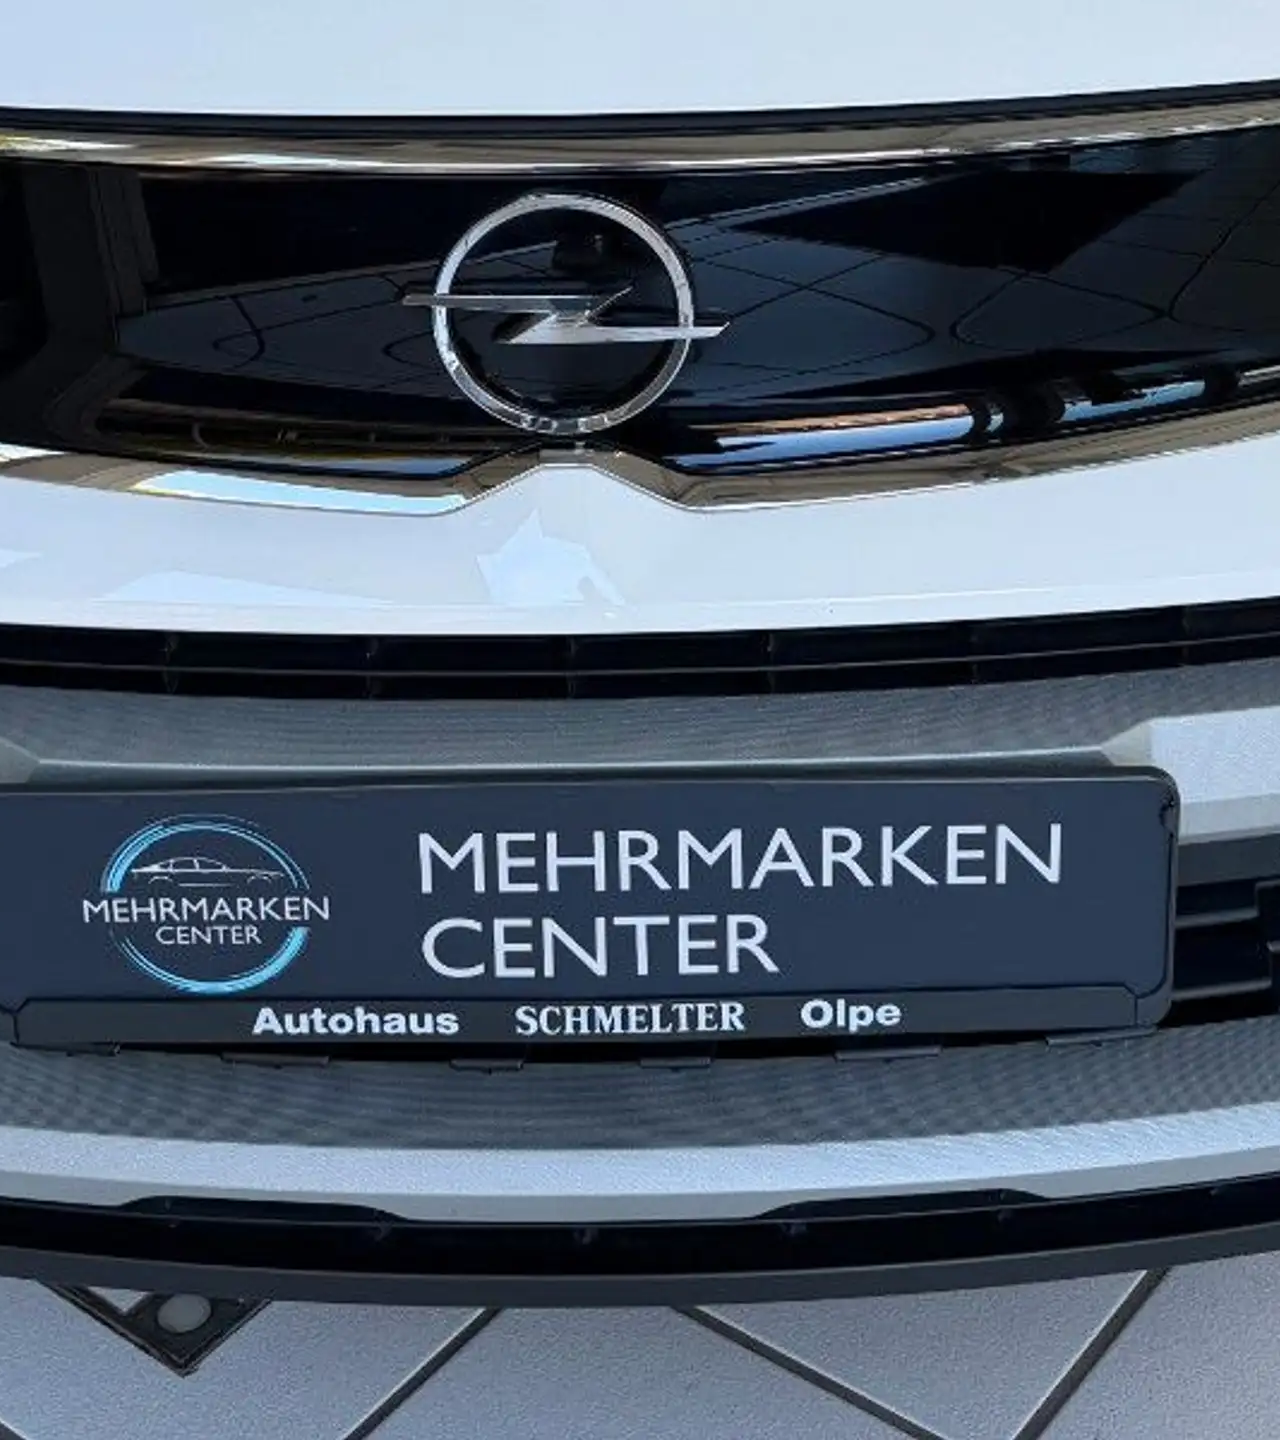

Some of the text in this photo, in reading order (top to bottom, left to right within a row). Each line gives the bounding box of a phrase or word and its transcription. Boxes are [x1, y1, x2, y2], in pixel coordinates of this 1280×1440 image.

[420, 825, 1062, 894] MEHRMARKEN
[84, 898, 330, 923] MEHRMARKEN
[155, 926, 262, 945] CENTER
[422, 916, 779, 978] CENTER
[252, 1000, 902, 1037] Autohaus SCHMELTER Olpe
